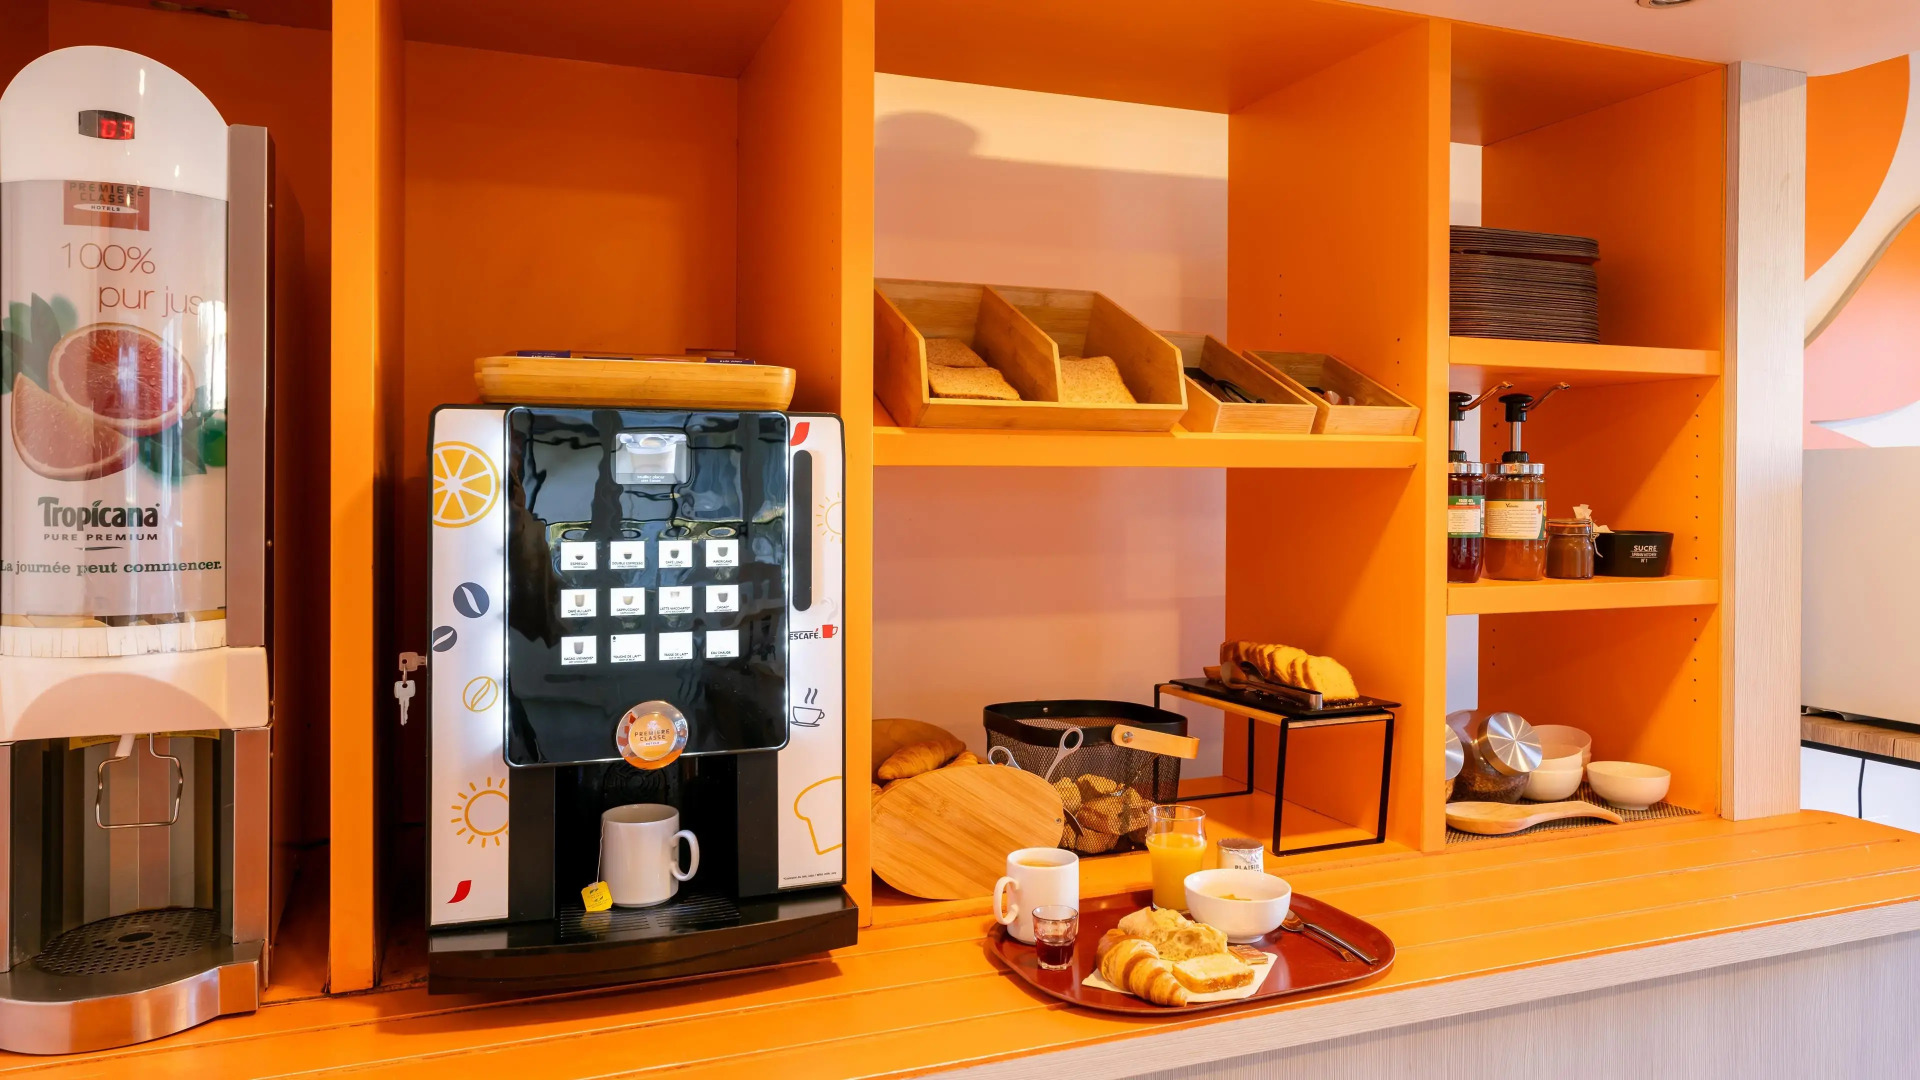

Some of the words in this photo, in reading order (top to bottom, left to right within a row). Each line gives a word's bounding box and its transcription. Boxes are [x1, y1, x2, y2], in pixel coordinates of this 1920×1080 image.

[80, 193, 135, 205] CLASSE
[61, 242, 156, 274] 100%
[98, 286, 155, 313] pur
[161, 286, 204, 317] jus
[44, 533, 78, 541] PURE
[86, 533, 158, 541] PREMIUM
[0, 560, 13, 572] La
[16, 560, 71, 575] journée
[77, 561, 118, 576] peut
[123, 560, 222, 573] commencer.
[790, 628, 819, 640] ESCAFÉ
[640, 734, 666, 742] CLASSE
